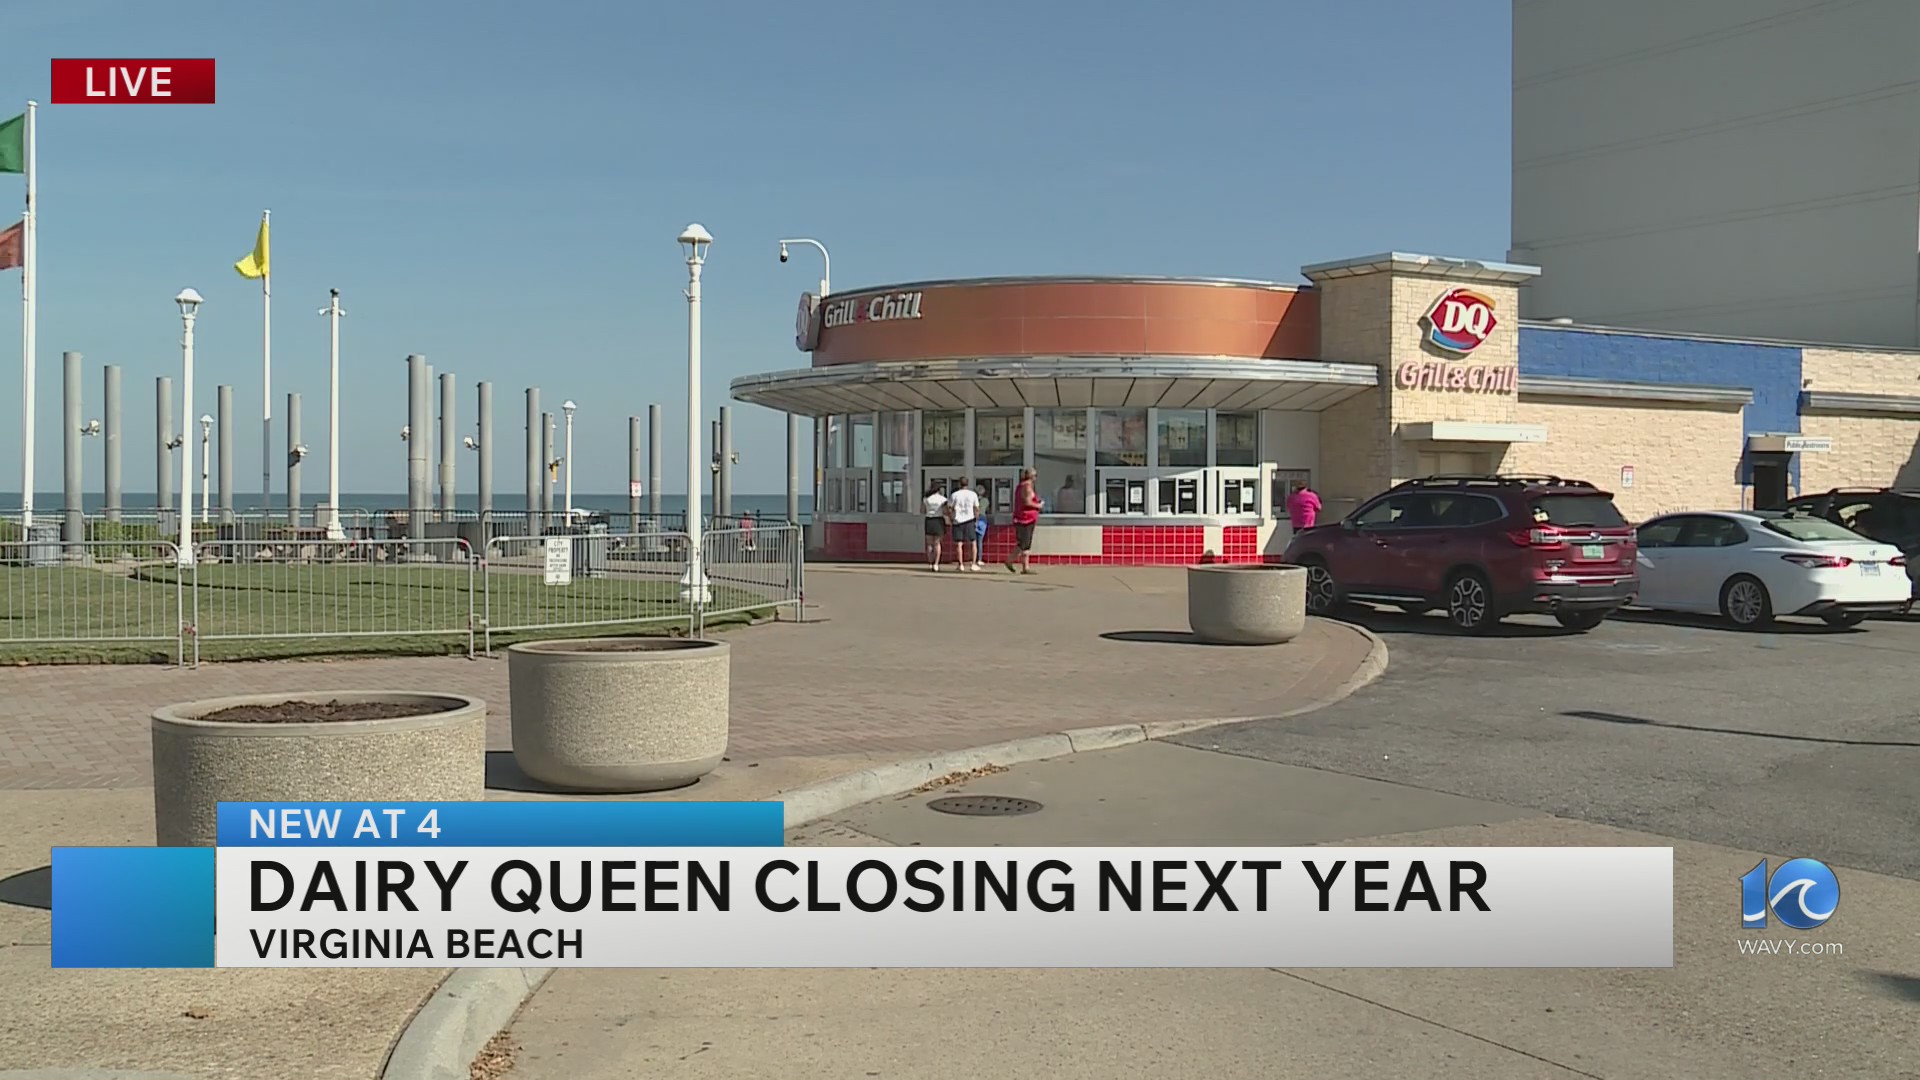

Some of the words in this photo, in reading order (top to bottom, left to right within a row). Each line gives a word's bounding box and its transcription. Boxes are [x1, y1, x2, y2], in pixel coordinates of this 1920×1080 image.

[825, 299, 856, 328] Grill
[869, 292, 922, 321] Chill
[1442, 300, 1490, 340] DQ
